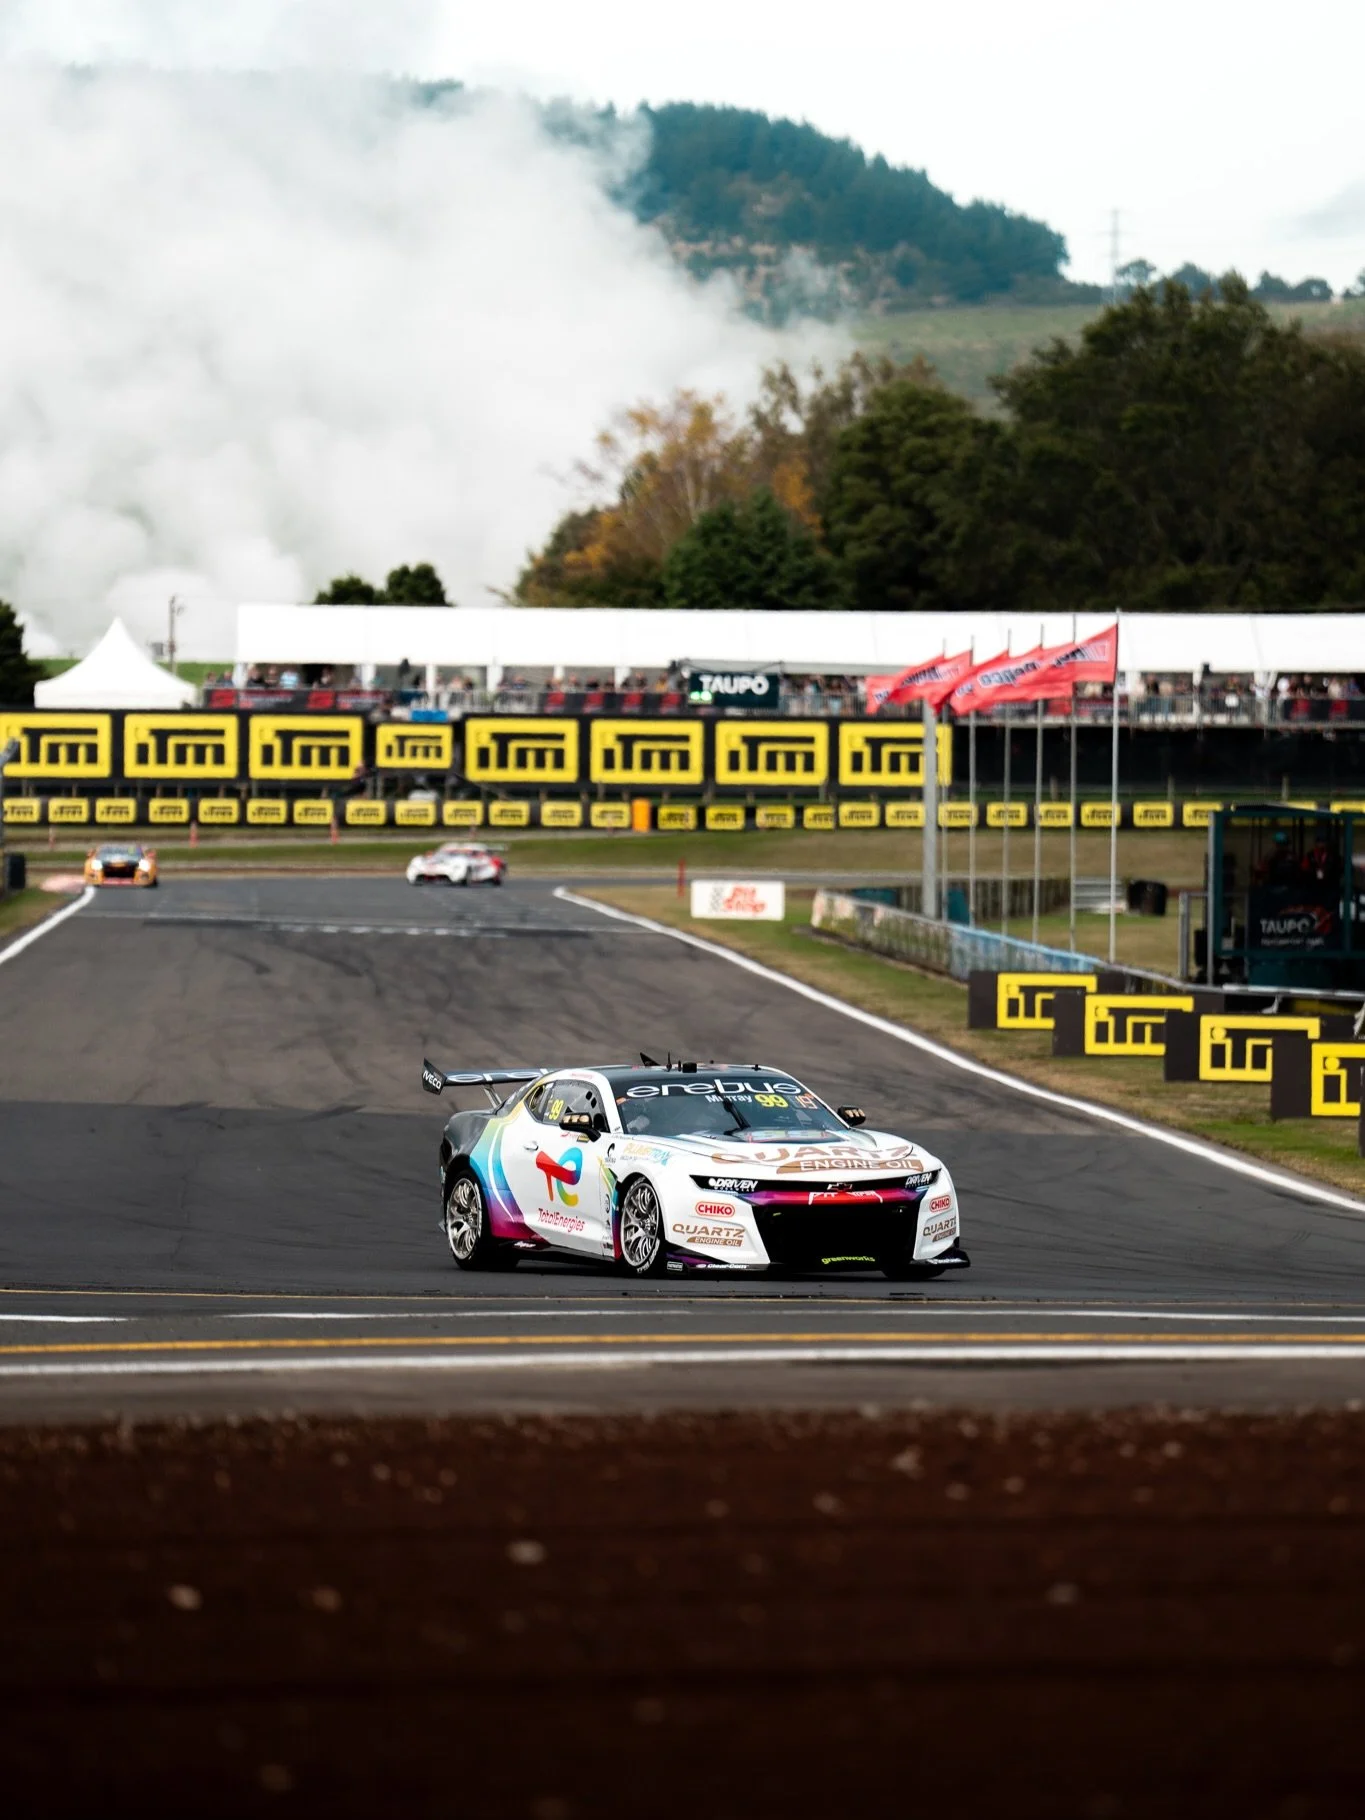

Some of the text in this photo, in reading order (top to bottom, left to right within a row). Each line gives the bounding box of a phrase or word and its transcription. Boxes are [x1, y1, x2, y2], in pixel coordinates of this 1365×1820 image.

[423, 1070, 442, 1090] IVECO
[626, 1079, 802, 1098] erebus
[754, 1094, 789, 1108] 99
[549, 1099, 564, 1120] 99
[800, 1158, 919, 1171] ENGINE OIL
[715, 1178, 758, 1189] DRIVEN
[697, 1204, 733, 1216] CHIKO
[930, 1197, 950, 1211] CHIKO
[538, 1207, 585, 1233] TotalEnergies
[672, 1223, 745, 1239] QUARTZ
[694, 1236, 740, 1247] ENGINE OIL
[821, 1255, 876, 1266] greenworks
